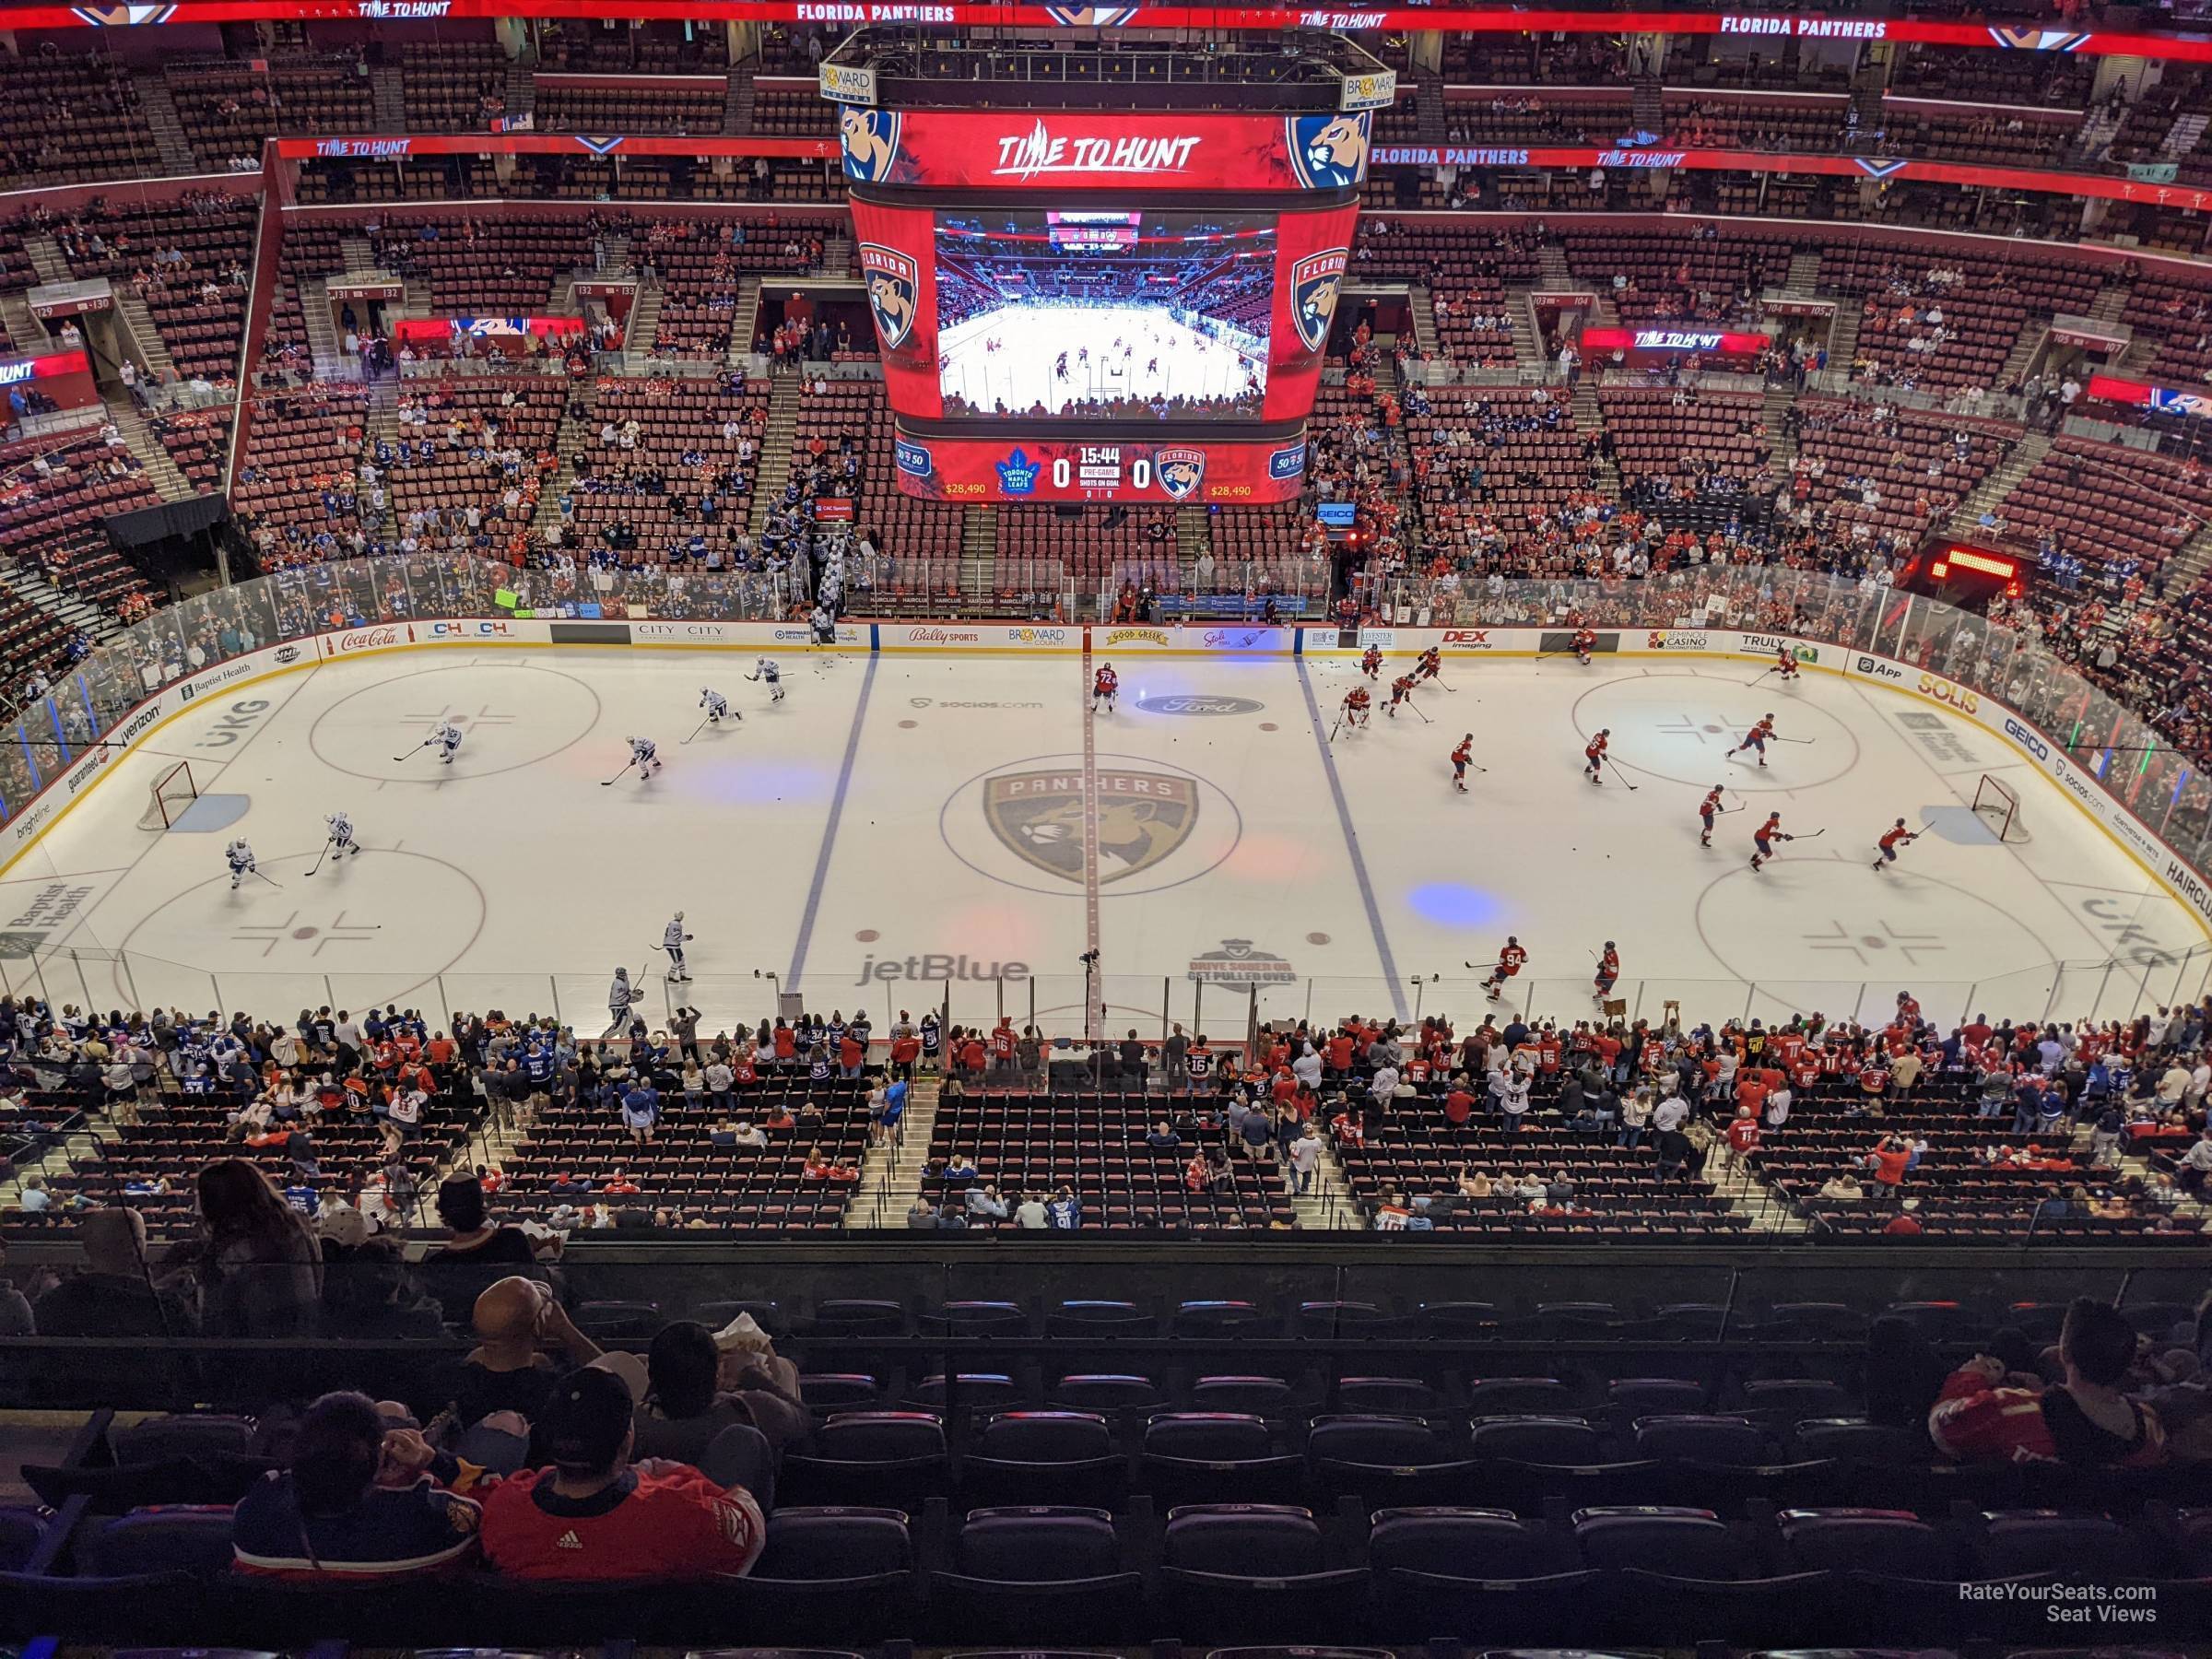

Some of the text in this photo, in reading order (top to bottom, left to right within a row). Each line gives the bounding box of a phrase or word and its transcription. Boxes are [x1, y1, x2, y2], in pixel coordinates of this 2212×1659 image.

[359, 0, 451, 18] TIME TO HUNT
[797, 5, 955, 21] FLORIDA PANTHERS
[1300, 10, 1386, 28] TIME TO HUNT
[1721, 17, 1887, 38] FLORIDA PANTHERS
[839, 86, 870, 96] COUNTY
[316, 138, 411, 157] TIME TO HUNT
[999, 118, 1202, 182] TIME TO HUNT
[1371, 148, 1528, 165] FLORIDA PANTHERS
[1597, 149, 1686, 167] TIME TO HUNT
[862, 253, 907, 276] FLORIDA
[382, 288, 397, 298] 132
[579, 286, 634, 295] 132 133
[1767, 304, 1783, 312] 104
[1634, 330, 1682, 347] TIME TO
[2104, 342, 2123, 353] 107
[912, 454, 924, 465] 50
[1080, 447, 1120, 464] 15:44
[1161, 451, 1198, 462] FLORIDA
[1277, 457, 1289, 469] 50
[1003, 468, 1033, 478] TORONTO
[1053, 458, 1070, 488] 0
[1084, 467, 1115, 476] PRE-GAME
[1133, 459, 1150, 488] 0
[946, 484, 985, 494] $28,490
[1211, 486, 1251, 496] $28,490
[434, 622, 507, 634] CH CH
[639, 625, 724, 636] CITY CITY
[1009, 627, 1065, 641] BROWARD
[341, 627, 398, 652] Coca-Cola
[909, 628, 979, 645] Bally SPORTS
[1112, 630, 1162, 642] GOOD GREEK
[1442, 630, 1489, 642] DEX
[1666, 638, 1707, 646] CASINO
[1743, 635, 1786, 648] TRULY
[1452, 641, 1492, 650] imaging
[275, 645, 300, 662] NHL
[194, 663, 252, 693] Baptist Health
[1100, 674, 1112, 683] 72
[1917, 673, 1980, 715] SOLIS
[1163, 697, 1239, 713] Ford
[123, 705, 160, 740] verizon
[2005, 718, 2049, 761] GEICO
[67, 754, 100, 794] guaranteed
[1009, 776, 1173, 796] PANTHERS
[16, 803, 51, 840] brightline
[7, 883, 68, 928] Baptist
[36, 885, 96, 927] Health
[1189, 961, 1292, 971] DRIVE SOBER OR
[1506, 955, 1522, 967] 94
[854, 954, 1030, 987] jetBlue
[1188, 971, 1298, 982] GET PULLED OVER
[317, 1030, 330, 1043] 16
[996, 1039, 1007, 1052] 16
[1748, 1043, 1763, 1053] 40
[1789, 1044, 1798, 1058] 11
[1191, 1059, 1206, 1073] 16
[1826, 1057, 1836, 1070] 11
[1412, 1071, 1424, 1082] 16
[1872, 1076, 1880, 1087] 3
[1256, 1085, 1265, 1096] 9
[556, 1541, 583, 1549] adidas
